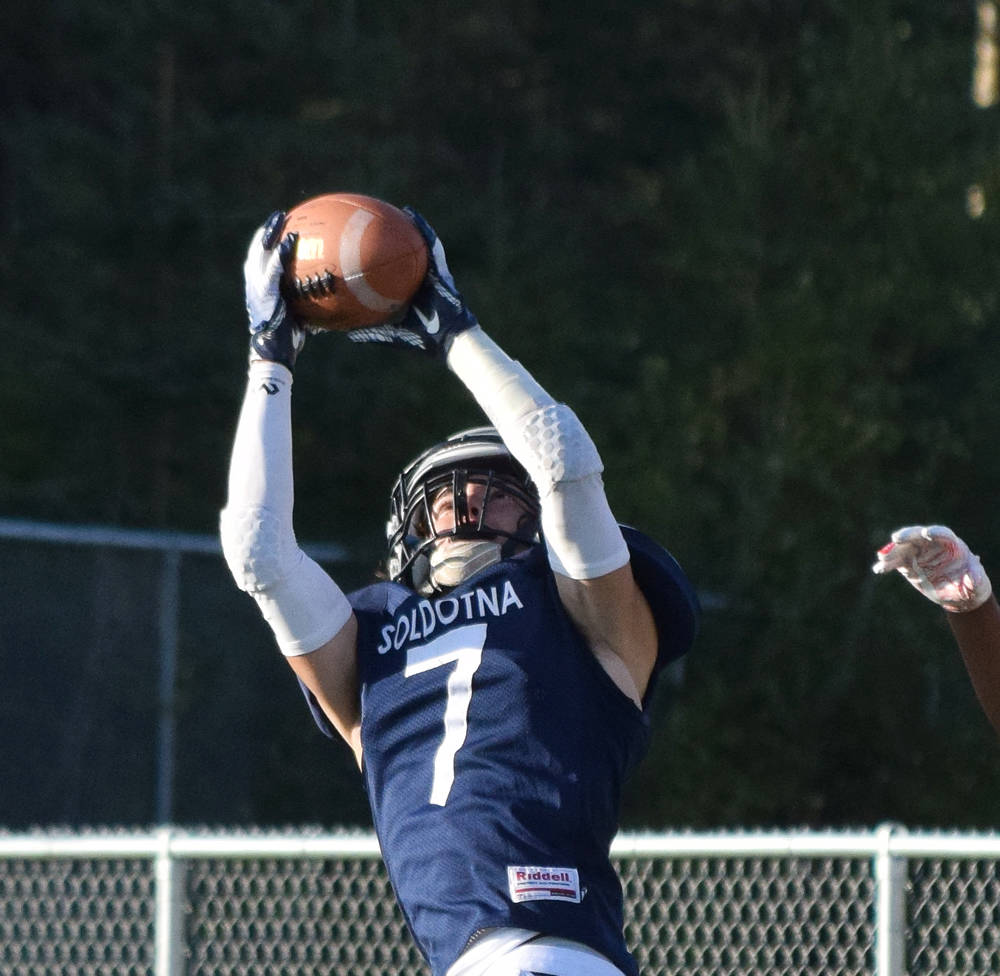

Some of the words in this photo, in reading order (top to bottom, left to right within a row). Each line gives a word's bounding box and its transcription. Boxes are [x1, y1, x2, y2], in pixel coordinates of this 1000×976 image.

[377, 580, 524, 655] SOLDOTNA
[404, 623, 488, 807] 7
[516, 871, 570, 882] Riddell
